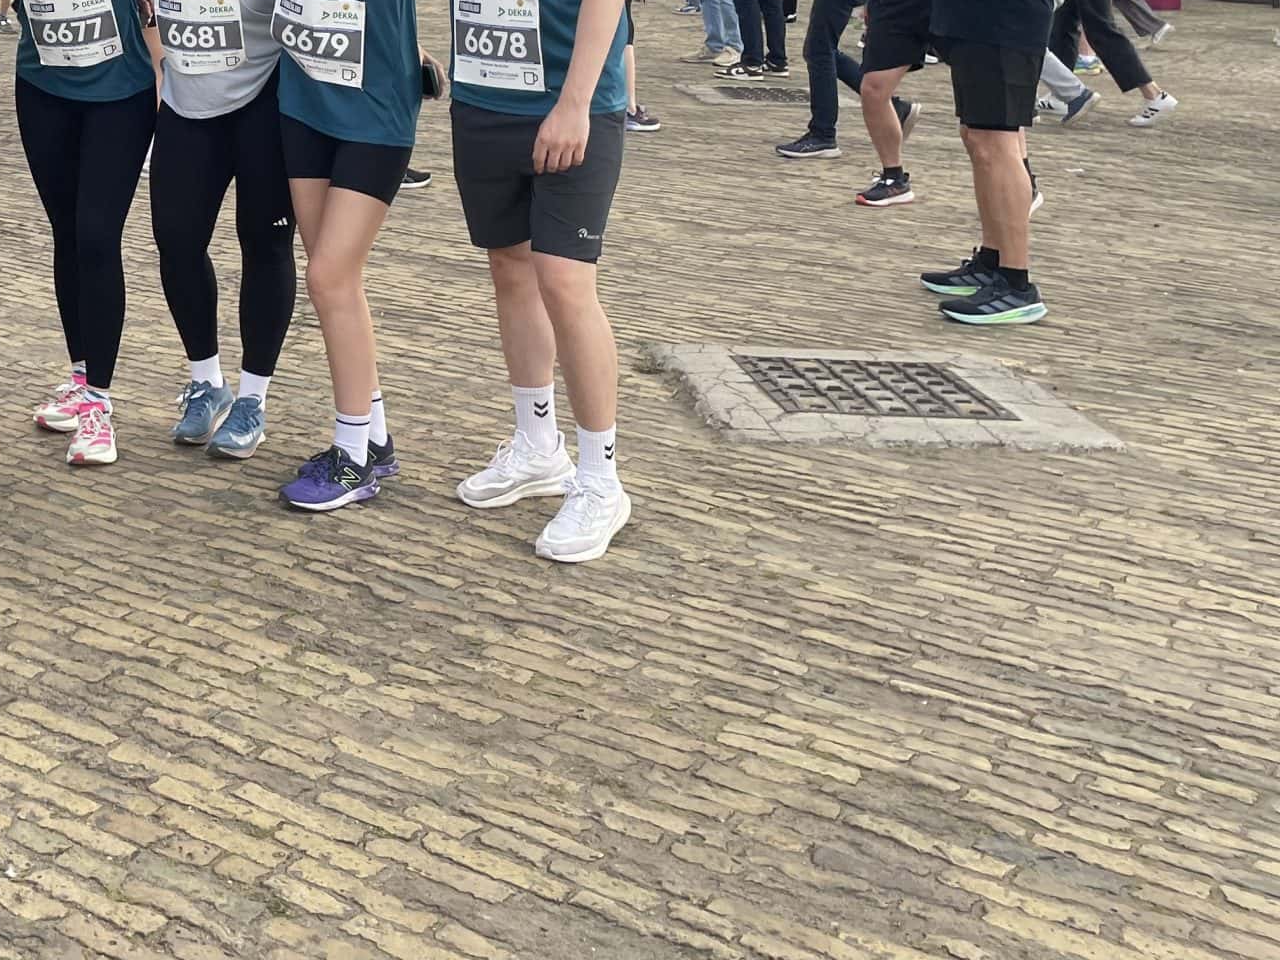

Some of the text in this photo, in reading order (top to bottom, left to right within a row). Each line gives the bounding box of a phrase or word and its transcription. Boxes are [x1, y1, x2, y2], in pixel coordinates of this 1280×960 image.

[209, 6, 234, 14] DEKRA
[332, 11, 359, 20] DEKRA
[507, 8, 533, 17] DEKRA
[42, 16, 102, 44] 6677
[168, 23, 227, 49] 6681
[281, 24, 350, 57] 6679
[464, 26, 528, 59] 6678
